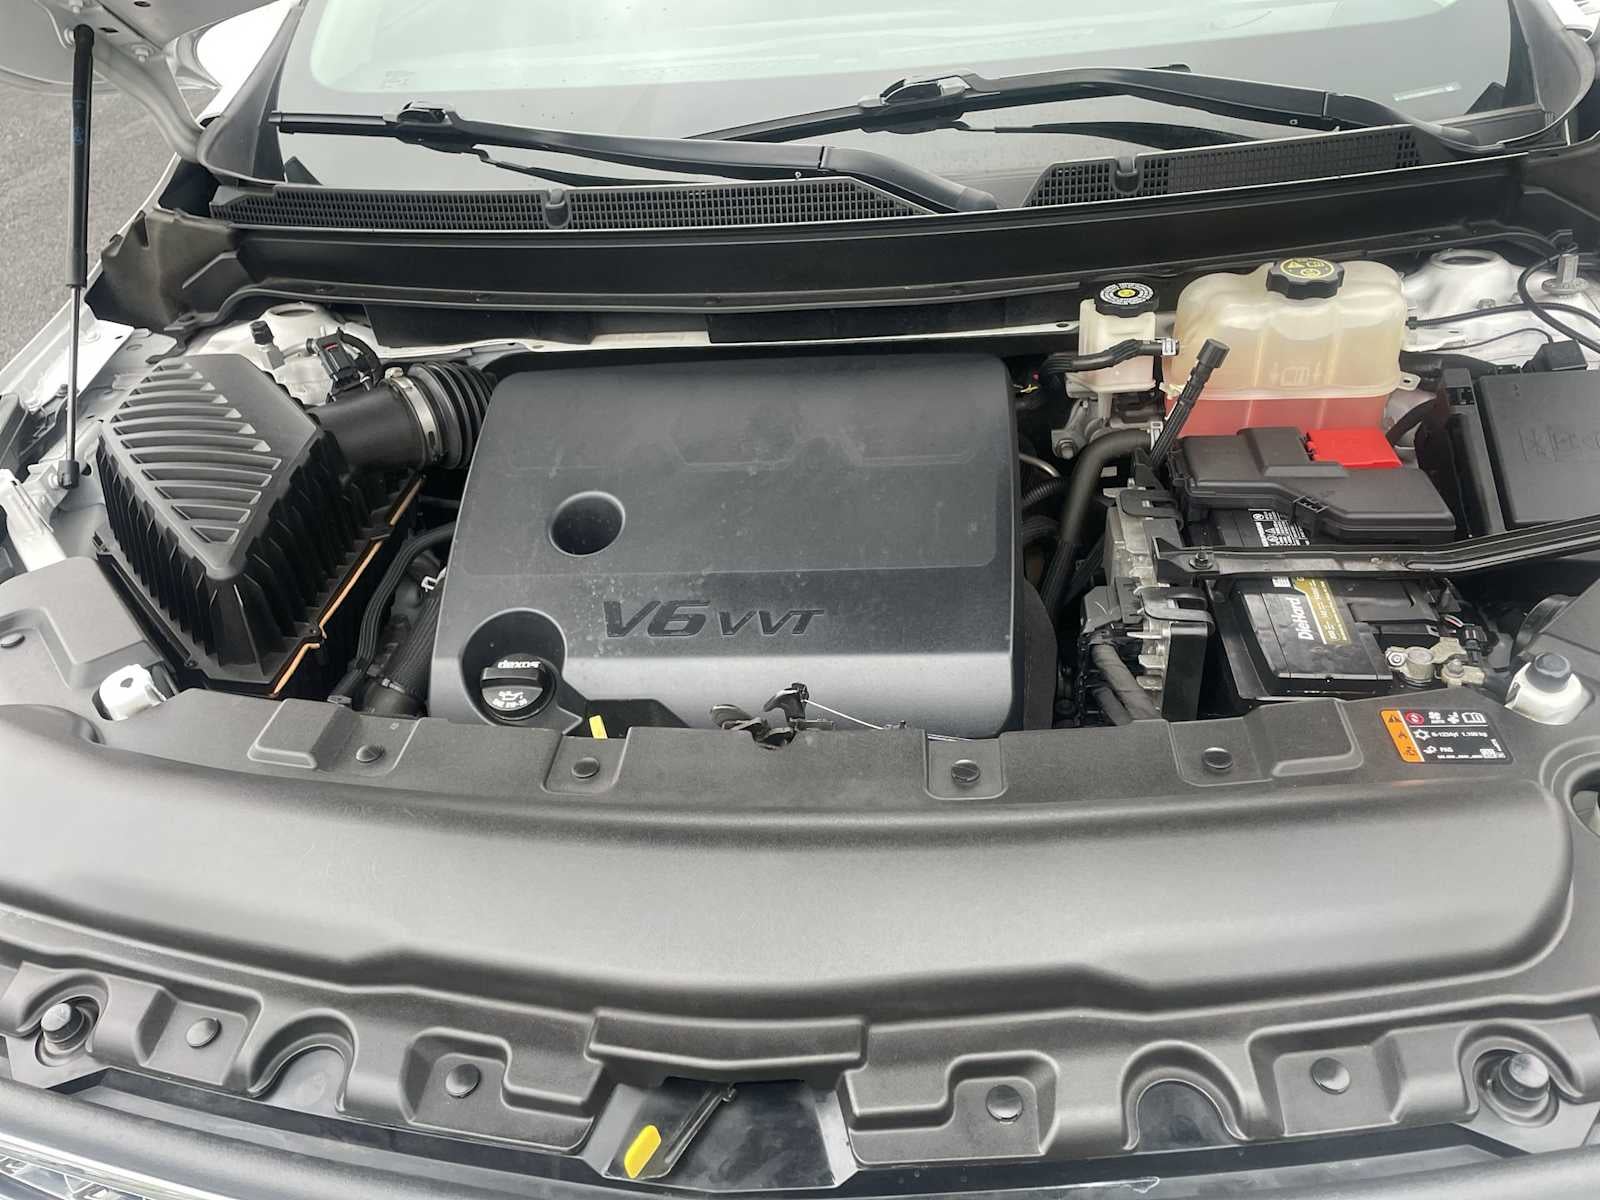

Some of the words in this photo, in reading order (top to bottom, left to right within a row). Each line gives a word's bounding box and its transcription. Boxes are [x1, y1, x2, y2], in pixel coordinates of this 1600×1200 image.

[602, 599, 711, 638] V6
[718, 609, 825, 636] VVT
[1286, 596, 1315, 641] DieHard
[497, 659, 542, 669] dexos
